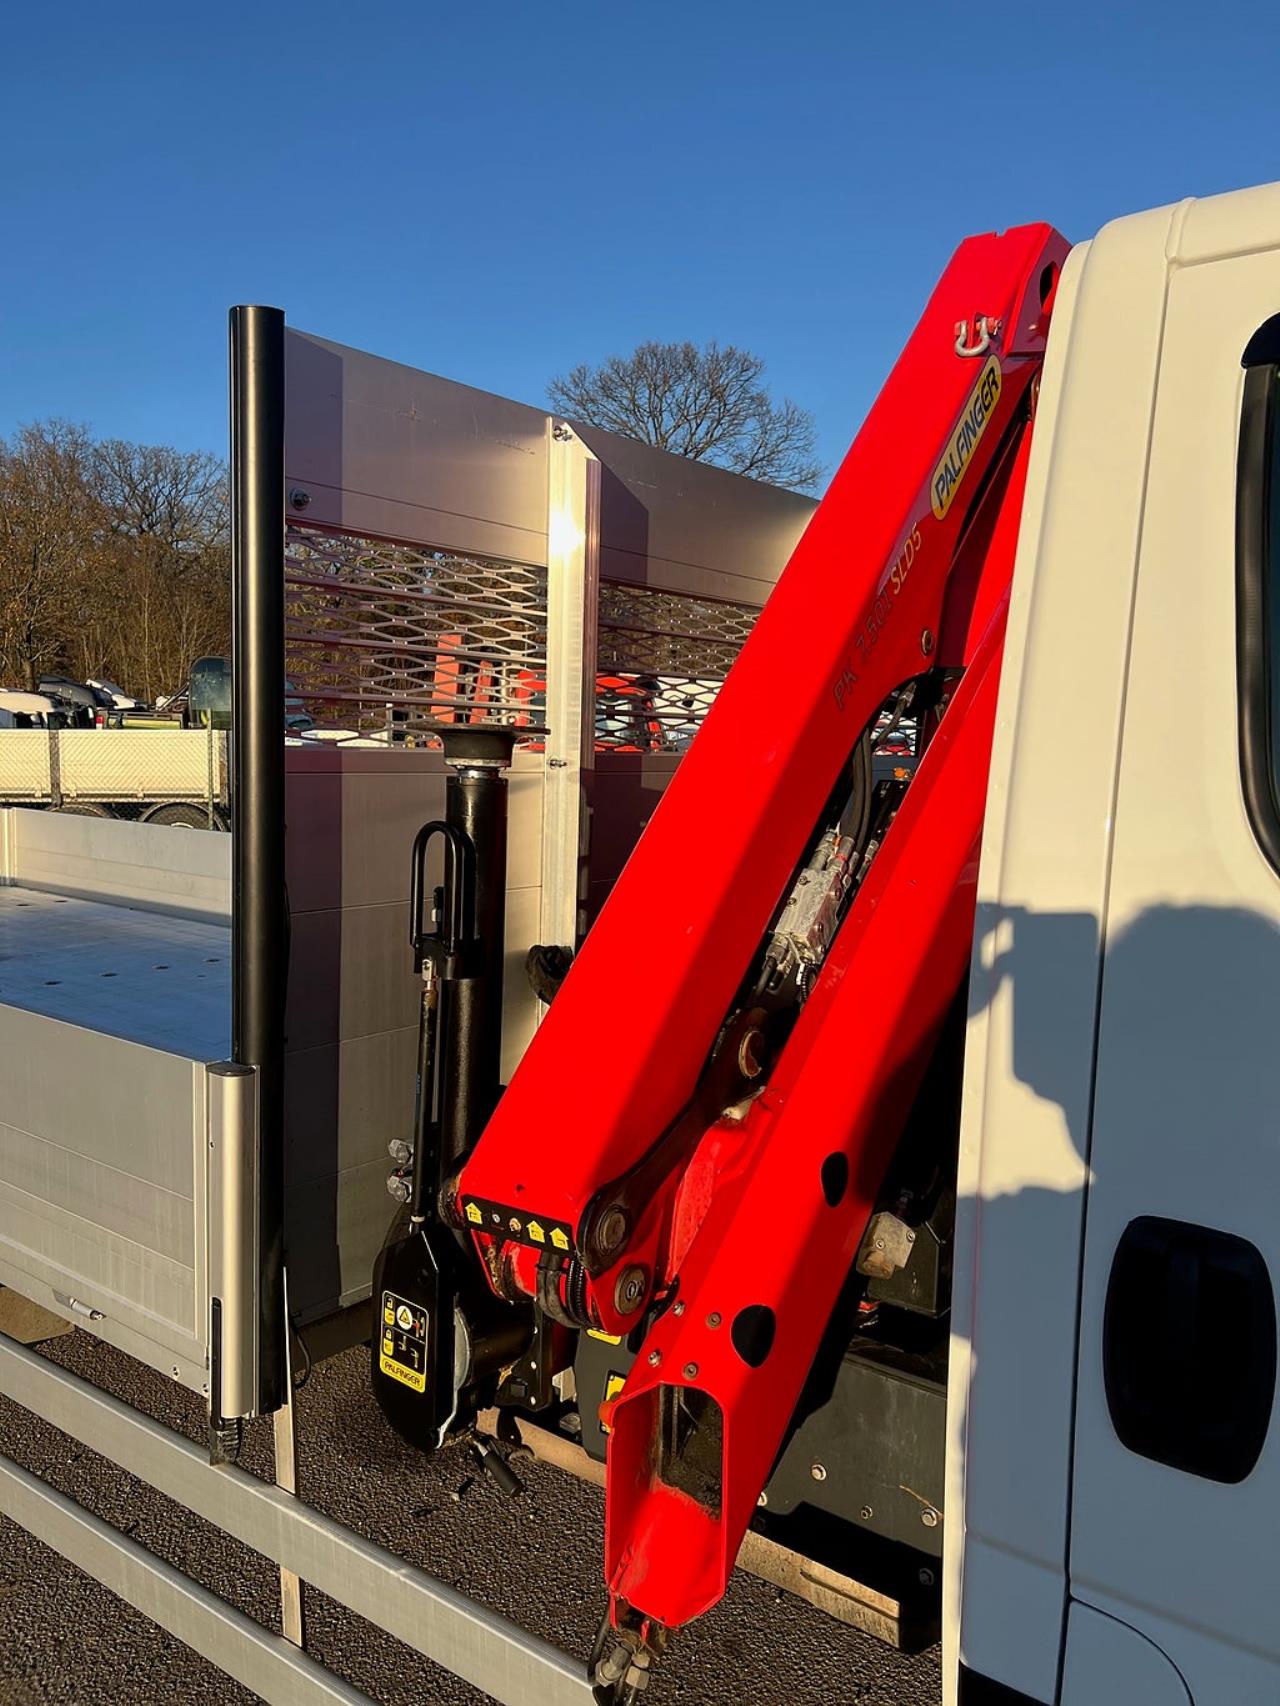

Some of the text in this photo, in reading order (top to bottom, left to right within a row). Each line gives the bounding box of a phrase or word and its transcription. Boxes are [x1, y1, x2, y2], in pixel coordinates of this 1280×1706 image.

[935, 366, 999, 510] PALFINGER
[833, 666, 857, 710] PK
[385, 1361, 420, 1386] PALFINGER
